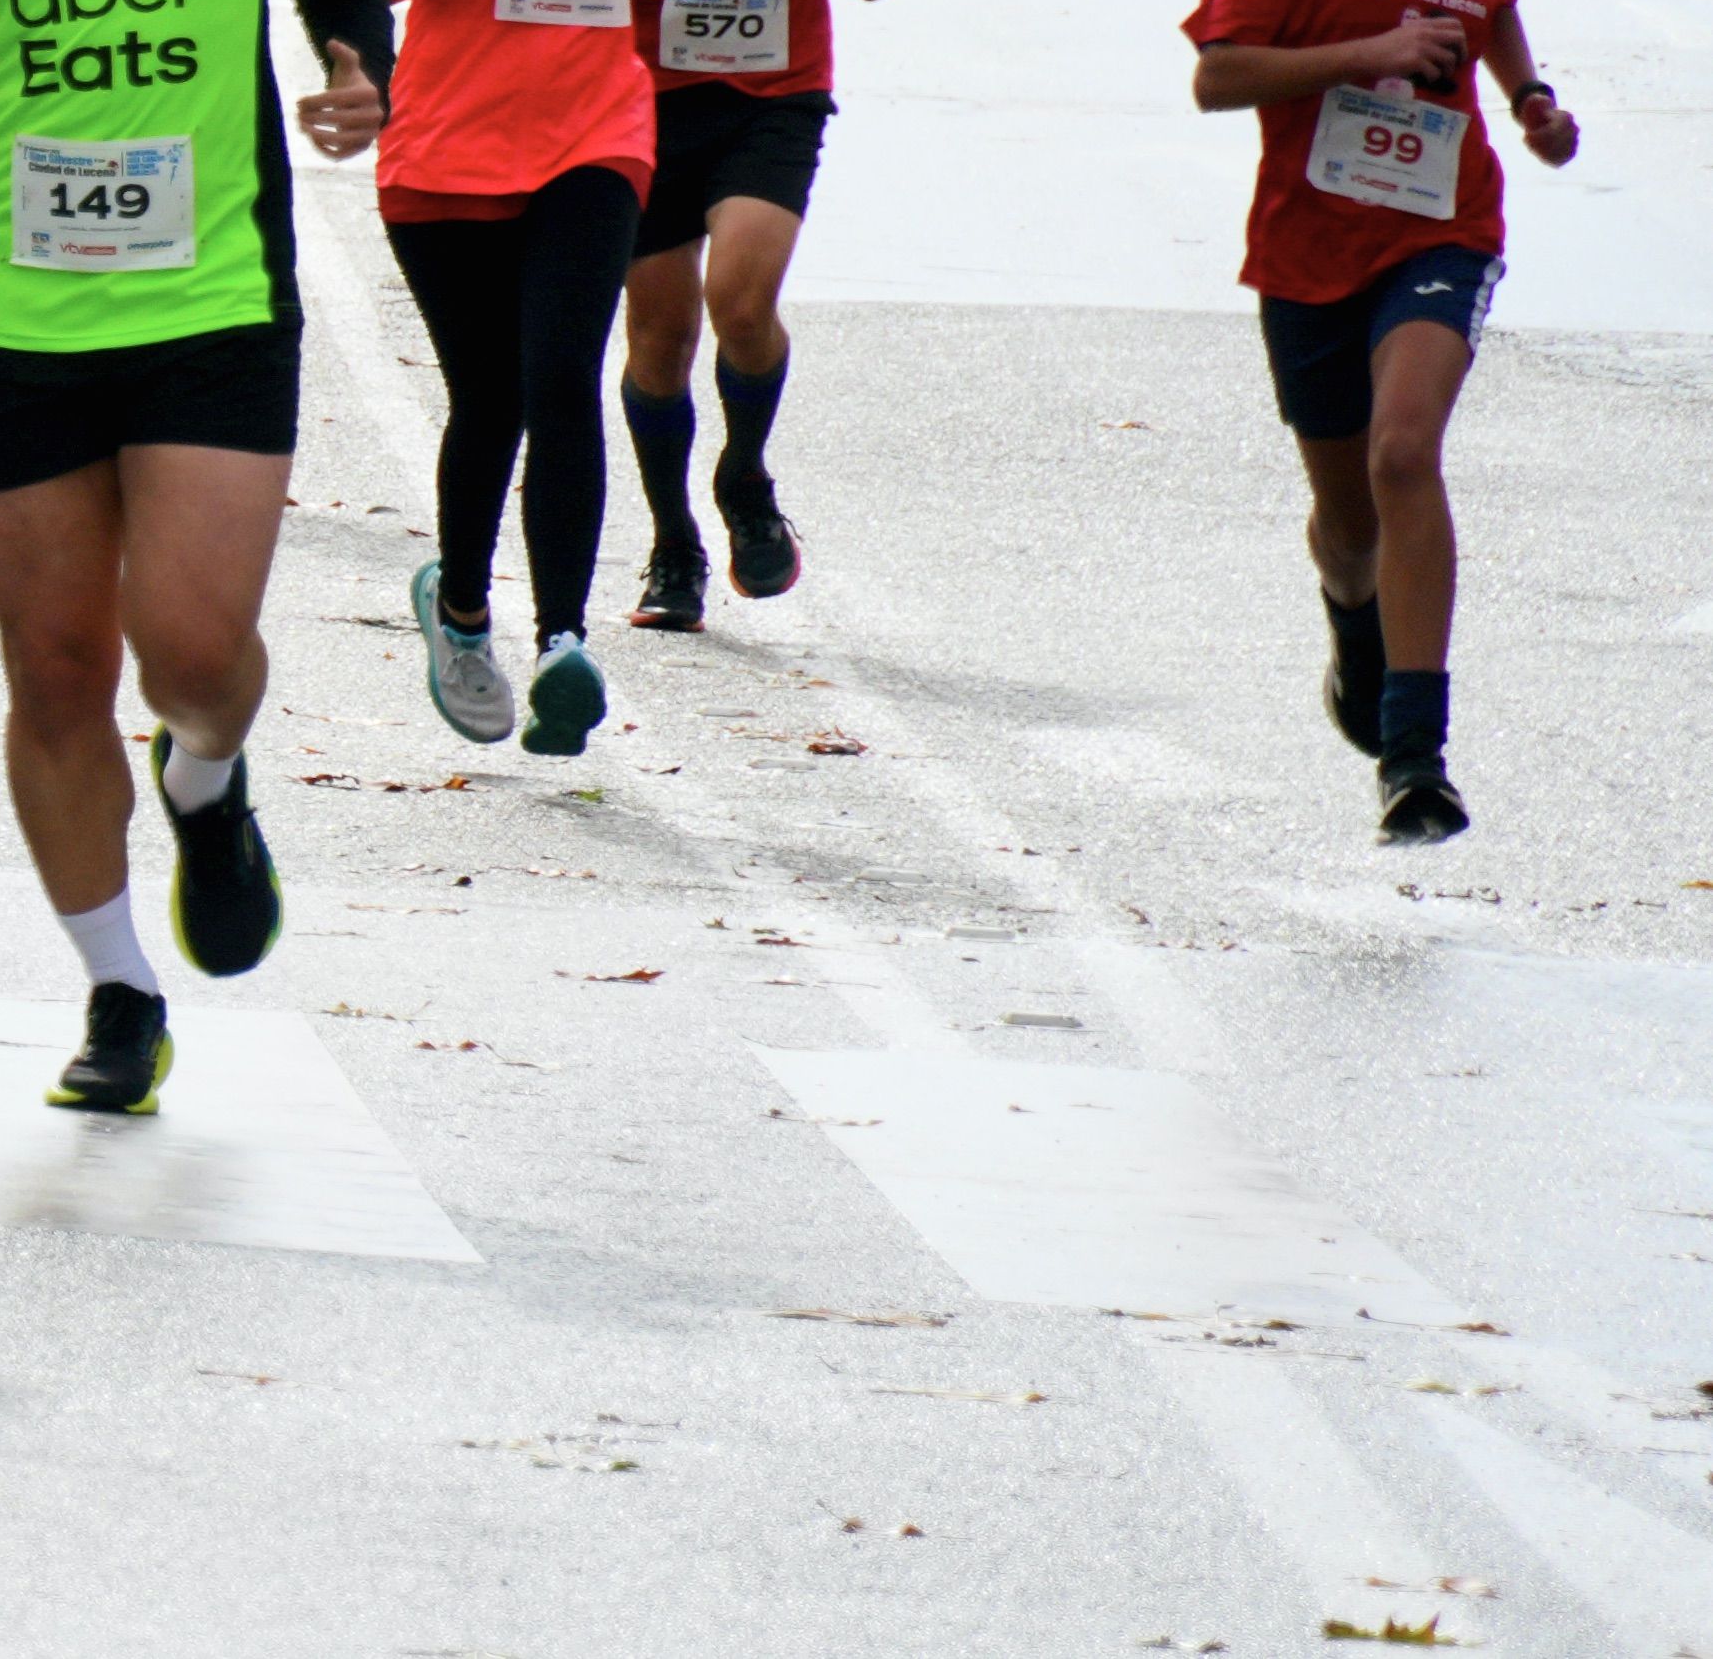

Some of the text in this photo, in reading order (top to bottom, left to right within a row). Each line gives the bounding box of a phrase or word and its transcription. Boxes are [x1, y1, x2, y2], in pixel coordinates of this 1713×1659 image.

[685, 13, 764, 39] 570
[19, 31, 199, 98] Eats
[1362, 125, 1424, 164] 99
[50, 182, 151, 220] 149
